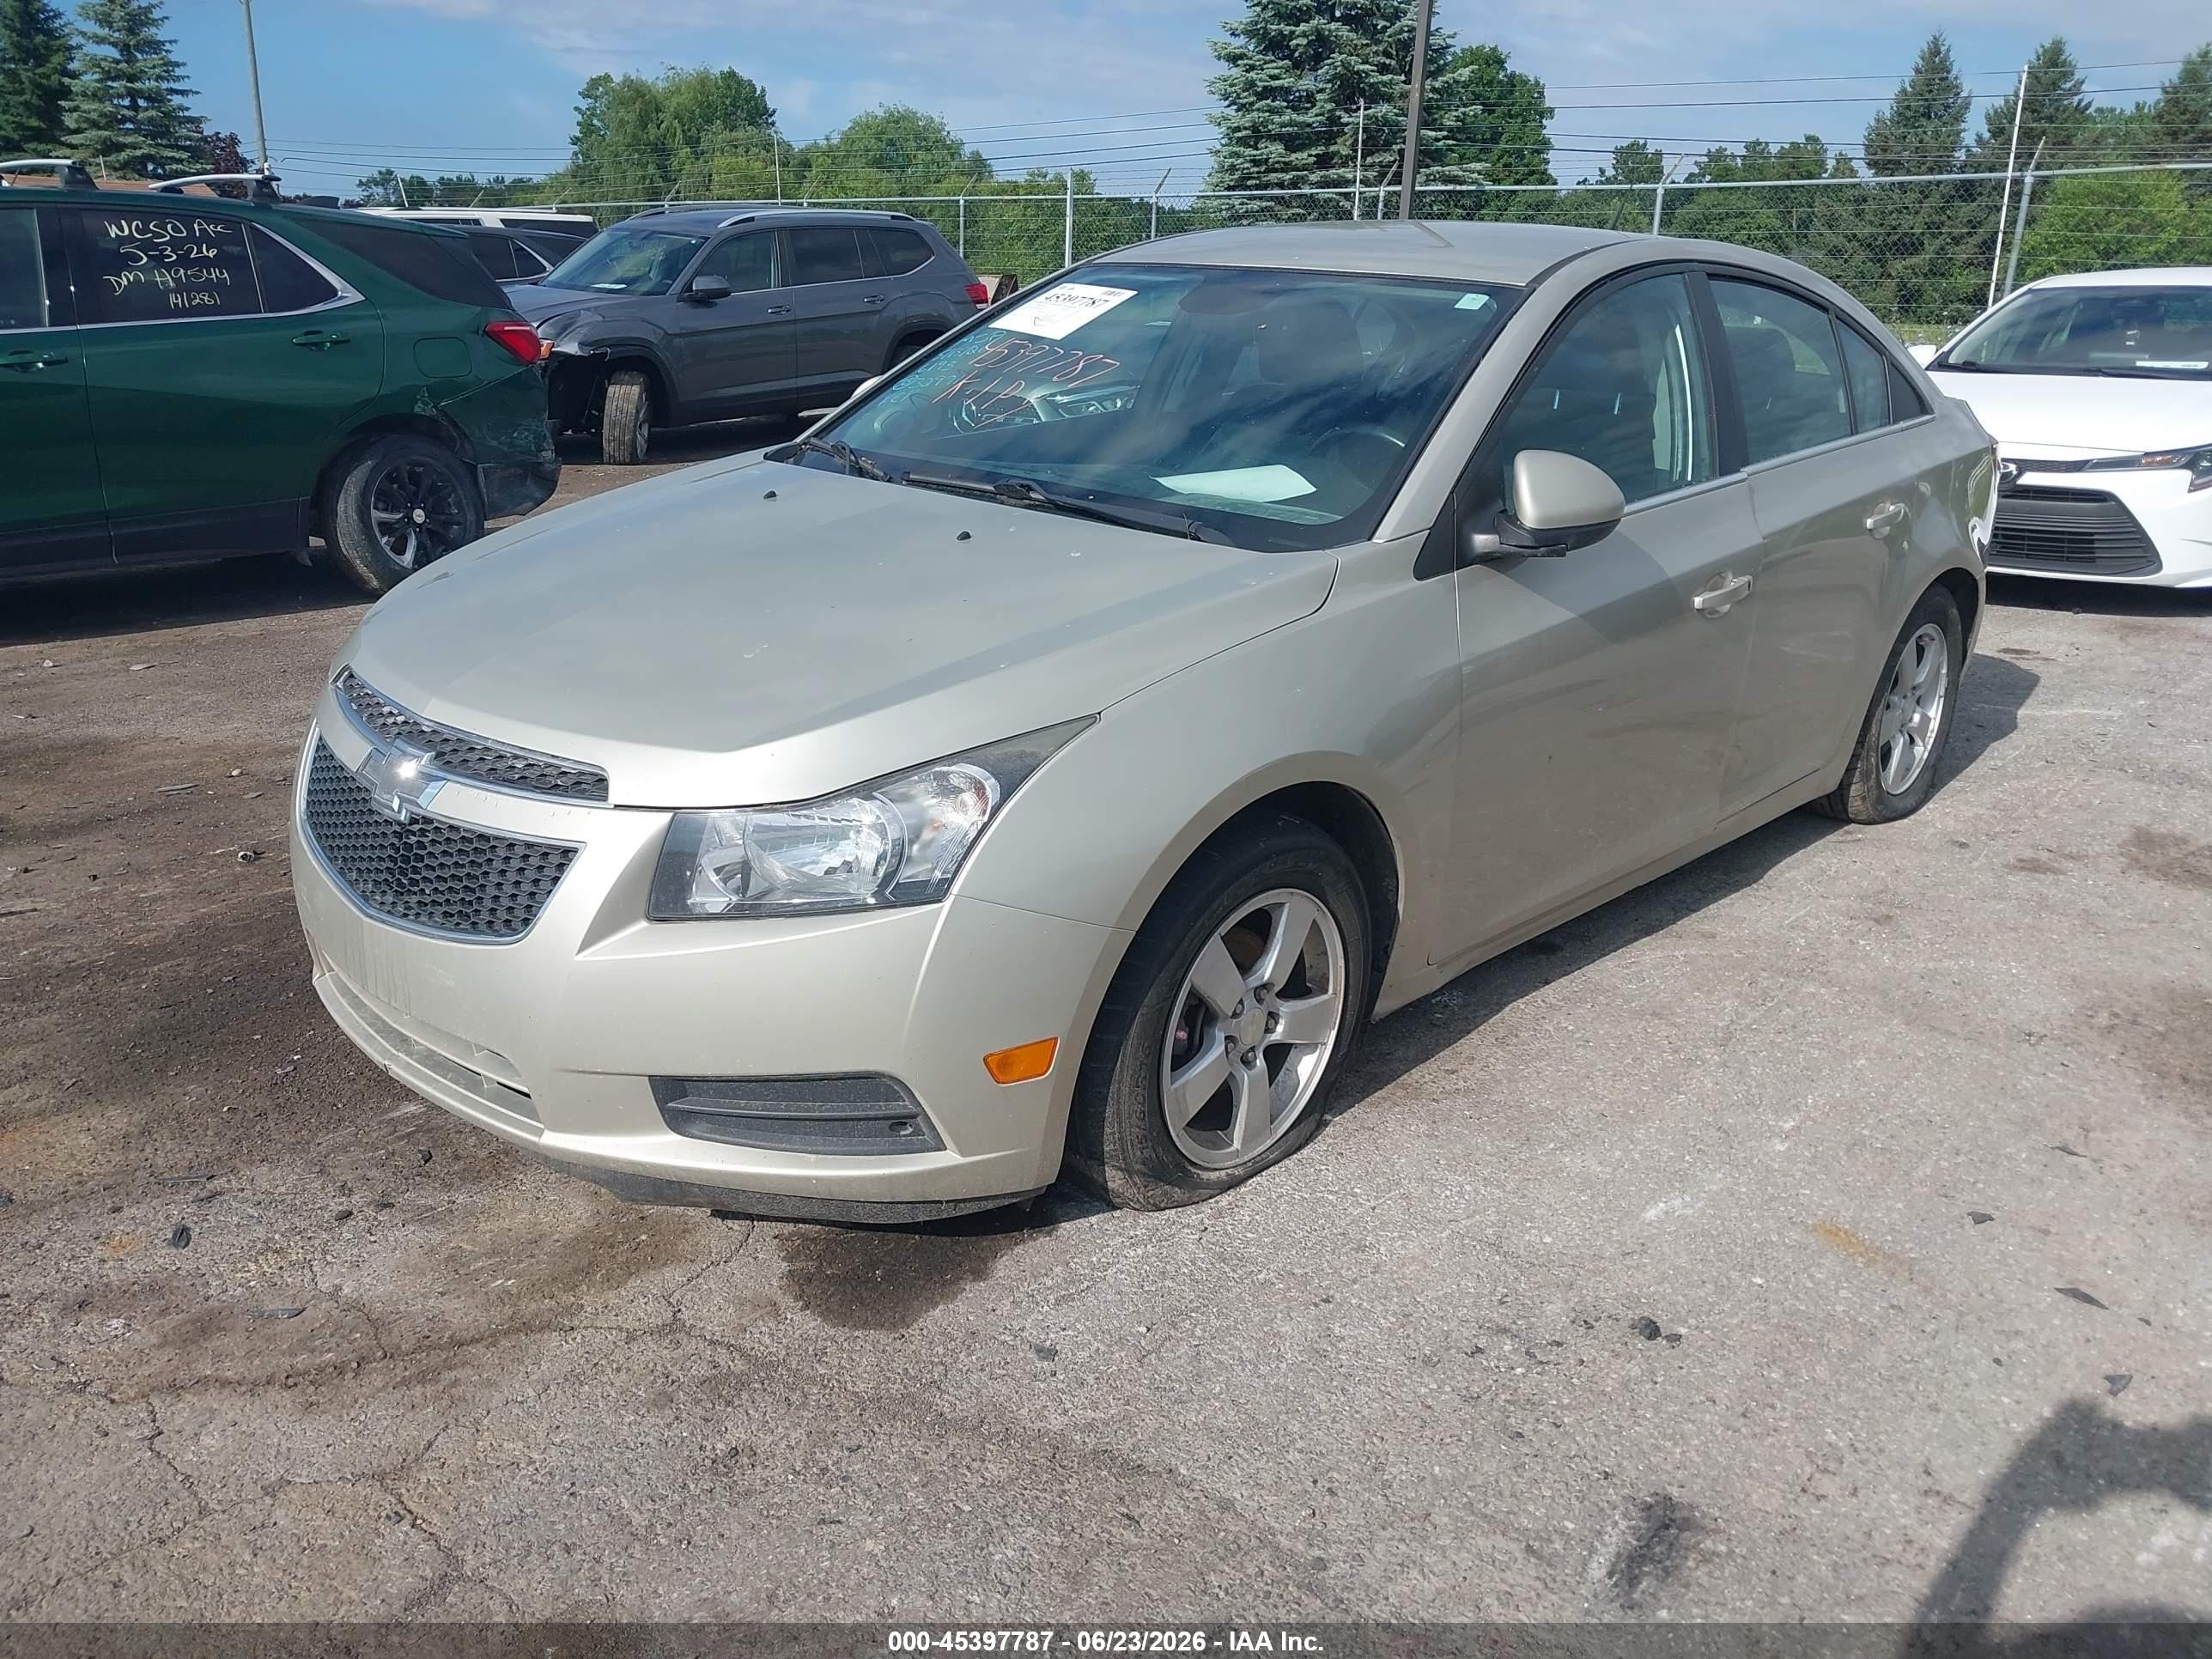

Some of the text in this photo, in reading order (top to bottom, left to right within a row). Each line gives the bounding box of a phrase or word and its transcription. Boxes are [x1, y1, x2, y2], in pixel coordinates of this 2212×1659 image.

[105, 219, 186, 241] WCSO
[120, 242, 218, 265] 5-3-26
[169, 292, 221, 309] 141281
[969, 337, 1120, 387] 45397787
